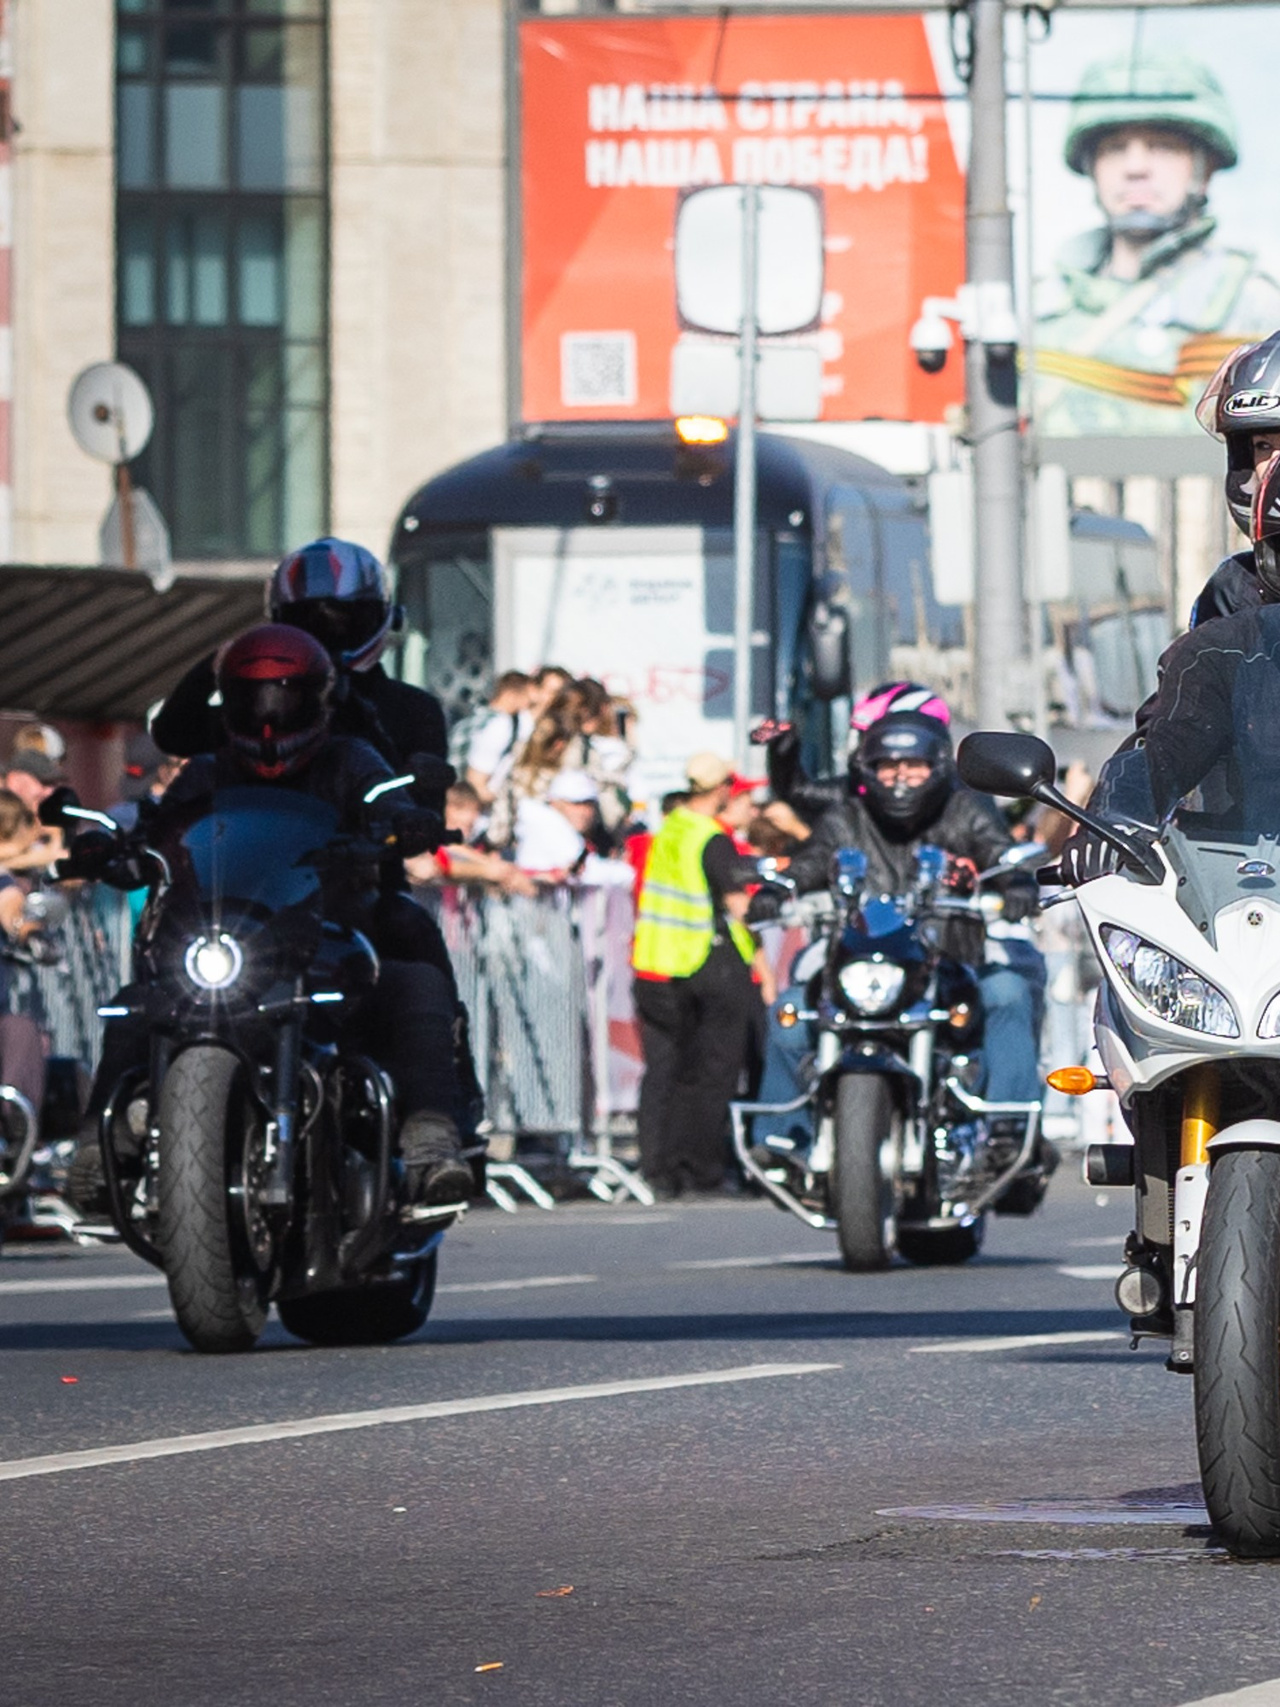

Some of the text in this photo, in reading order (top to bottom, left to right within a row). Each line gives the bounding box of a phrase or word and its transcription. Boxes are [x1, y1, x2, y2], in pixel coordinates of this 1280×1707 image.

[589, 82, 923, 132] НАША СТРАНА,
[586, 136, 928, 190] НАША ПОБЕДА!
